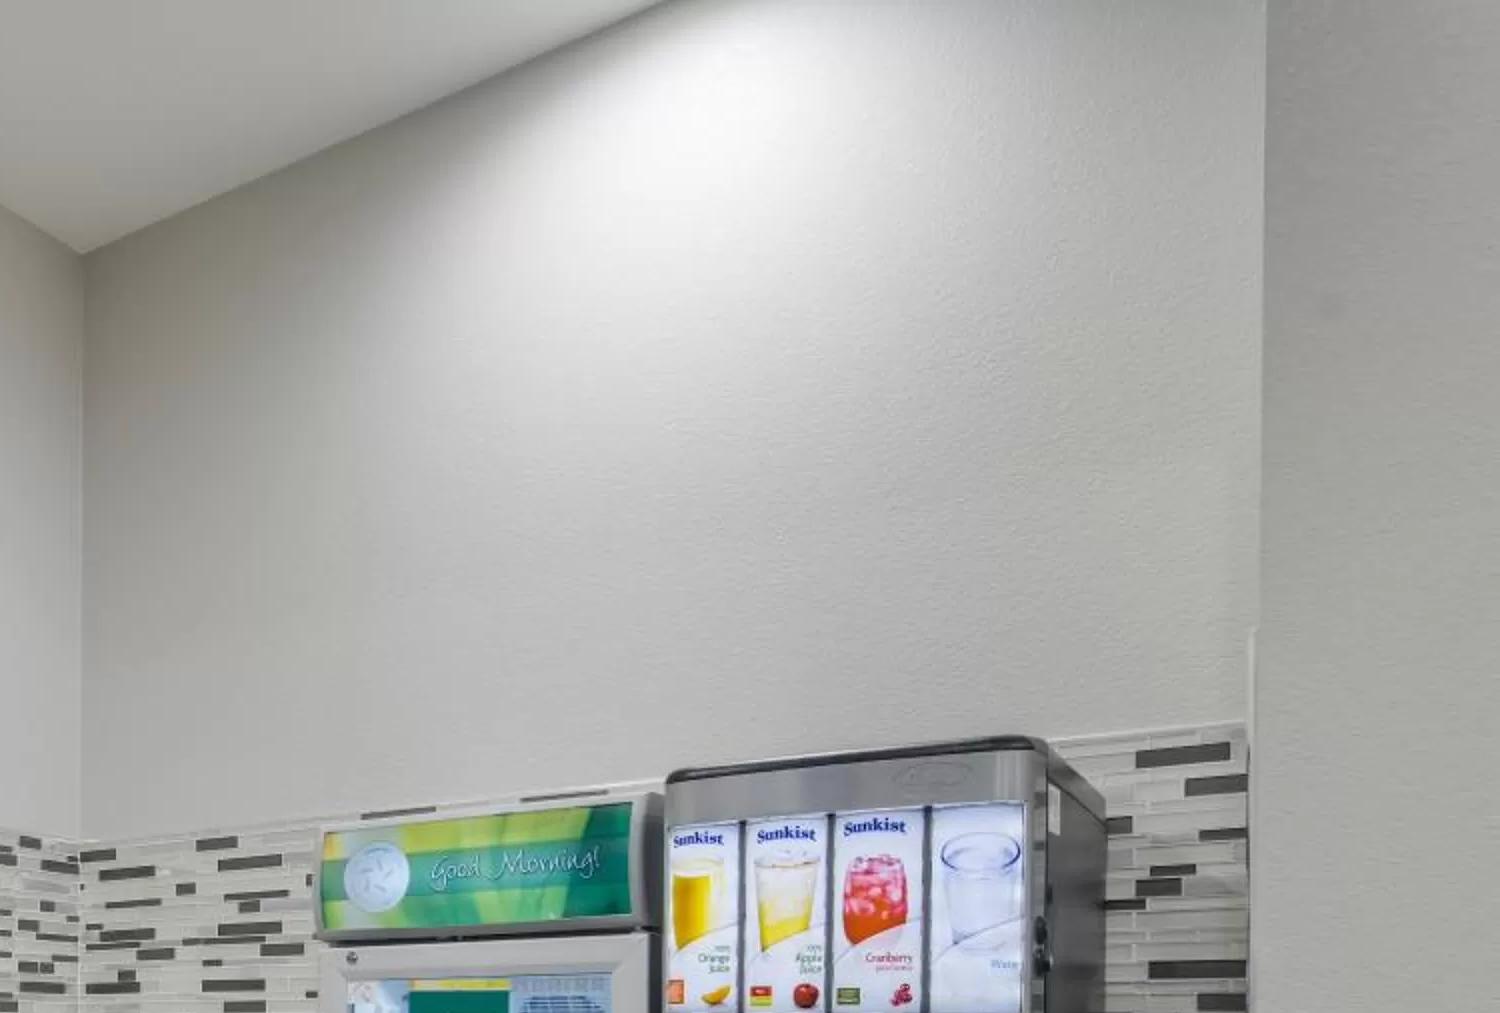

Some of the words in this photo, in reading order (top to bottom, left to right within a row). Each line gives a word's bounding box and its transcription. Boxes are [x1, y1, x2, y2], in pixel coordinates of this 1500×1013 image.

[757, 825, 818, 844] Sunkist
[843, 817, 907, 837] Sunkist
[673, 830, 725, 848] Sunkist
[429, 854, 481, 892] Good
[484, 845, 601, 880] Morning!
[697, 952, 731, 964] Orange
[795, 952, 823, 964] Apple
[865, 951, 913, 965] Cranberry
